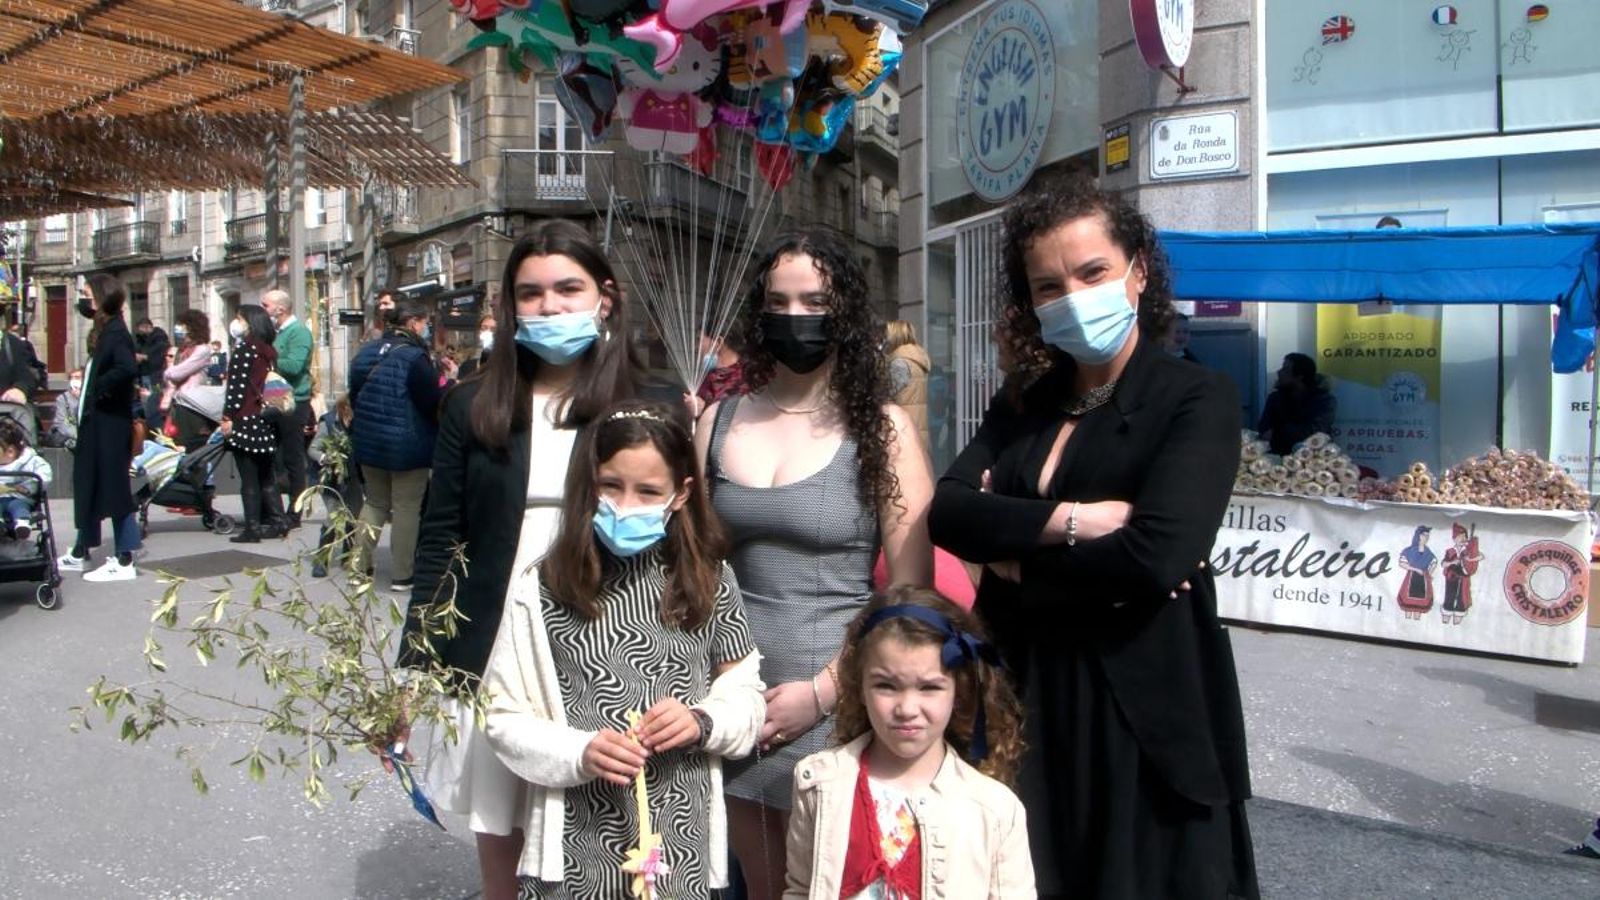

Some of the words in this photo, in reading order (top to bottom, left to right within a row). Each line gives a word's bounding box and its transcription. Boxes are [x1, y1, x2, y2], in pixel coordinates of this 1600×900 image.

[975, 37, 1036, 107] ENGLISH
[980, 95, 1027, 157] GYM
[1174, 140, 1188, 151] da
[1193, 136, 1227, 149] Ronda
[1158, 157, 1172, 167] de
[1176, 155, 1197, 165] Don
[1200, 152, 1232, 163] Bosco
[1343, 332, 1414, 341] APROBADO
[1322, 347, 1437, 358] GARANTIZADO
[1228, 504, 1286, 532] illas
[1210, 532, 1392, 579] staleiro
[1519, 549, 1582, 576] Rosquillas
[1272, 584, 1330, 605] dende
[1339, 591, 1383, 612] 1941
[1511, 583, 1583, 618] CRISTALEIRO
